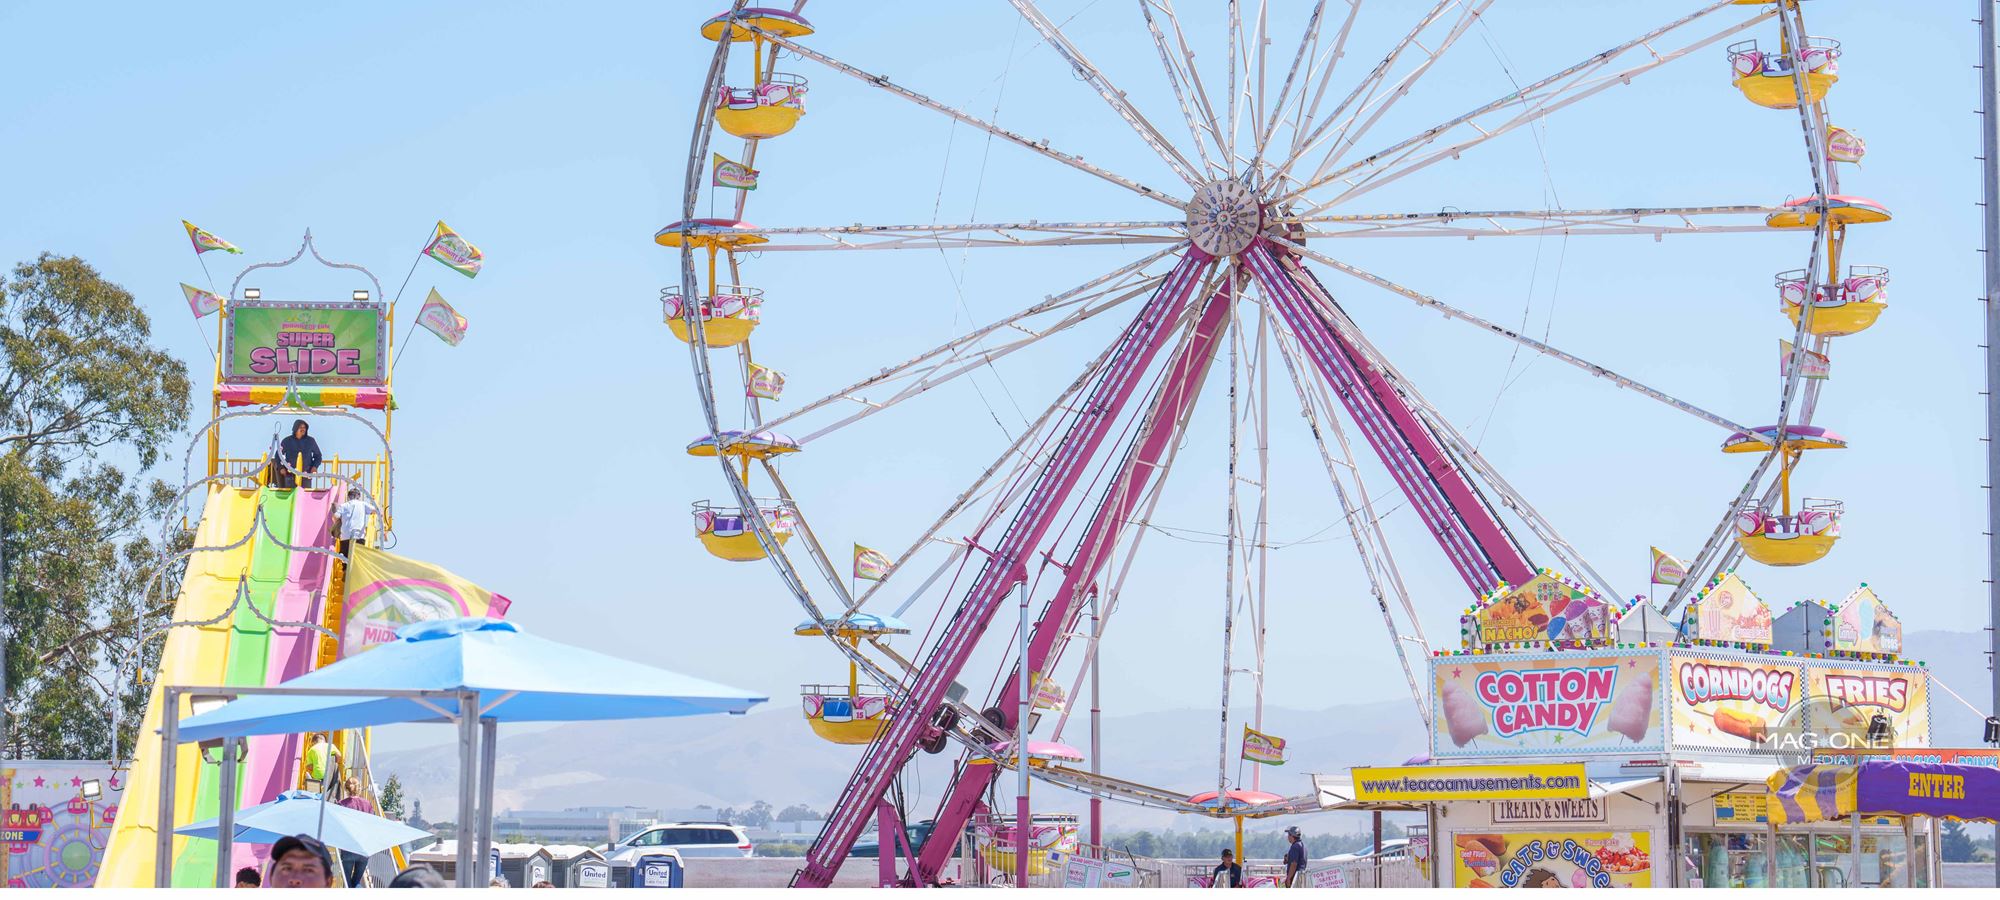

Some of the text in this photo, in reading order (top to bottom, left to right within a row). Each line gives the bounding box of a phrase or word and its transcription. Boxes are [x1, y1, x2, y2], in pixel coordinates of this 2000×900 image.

[1851, 294, 1856, 303] 5
[277, 332, 335, 348] SUPER
[249, 347, 361, 374] SLIDE
[1485, 626, 1539, 642] NACHOS
[1476, 666, 1618, 706] COTTON
[1680, 662, 1794, 713] CORNDOGS
[1825, 675, 1908, 712] FRIES
[856, 711, 864, 719] 15
[1493, 702, 1600, 738] CANDY
[1361, 774, 1580, 793] www.teacoamusements.com
[1908, 772, 1966, 800] ENTER
[1500, 800, 1599, 819] TREATS & SWEETS
[584, 870, 606, 878] United
[649, 869, 668, 877] United
